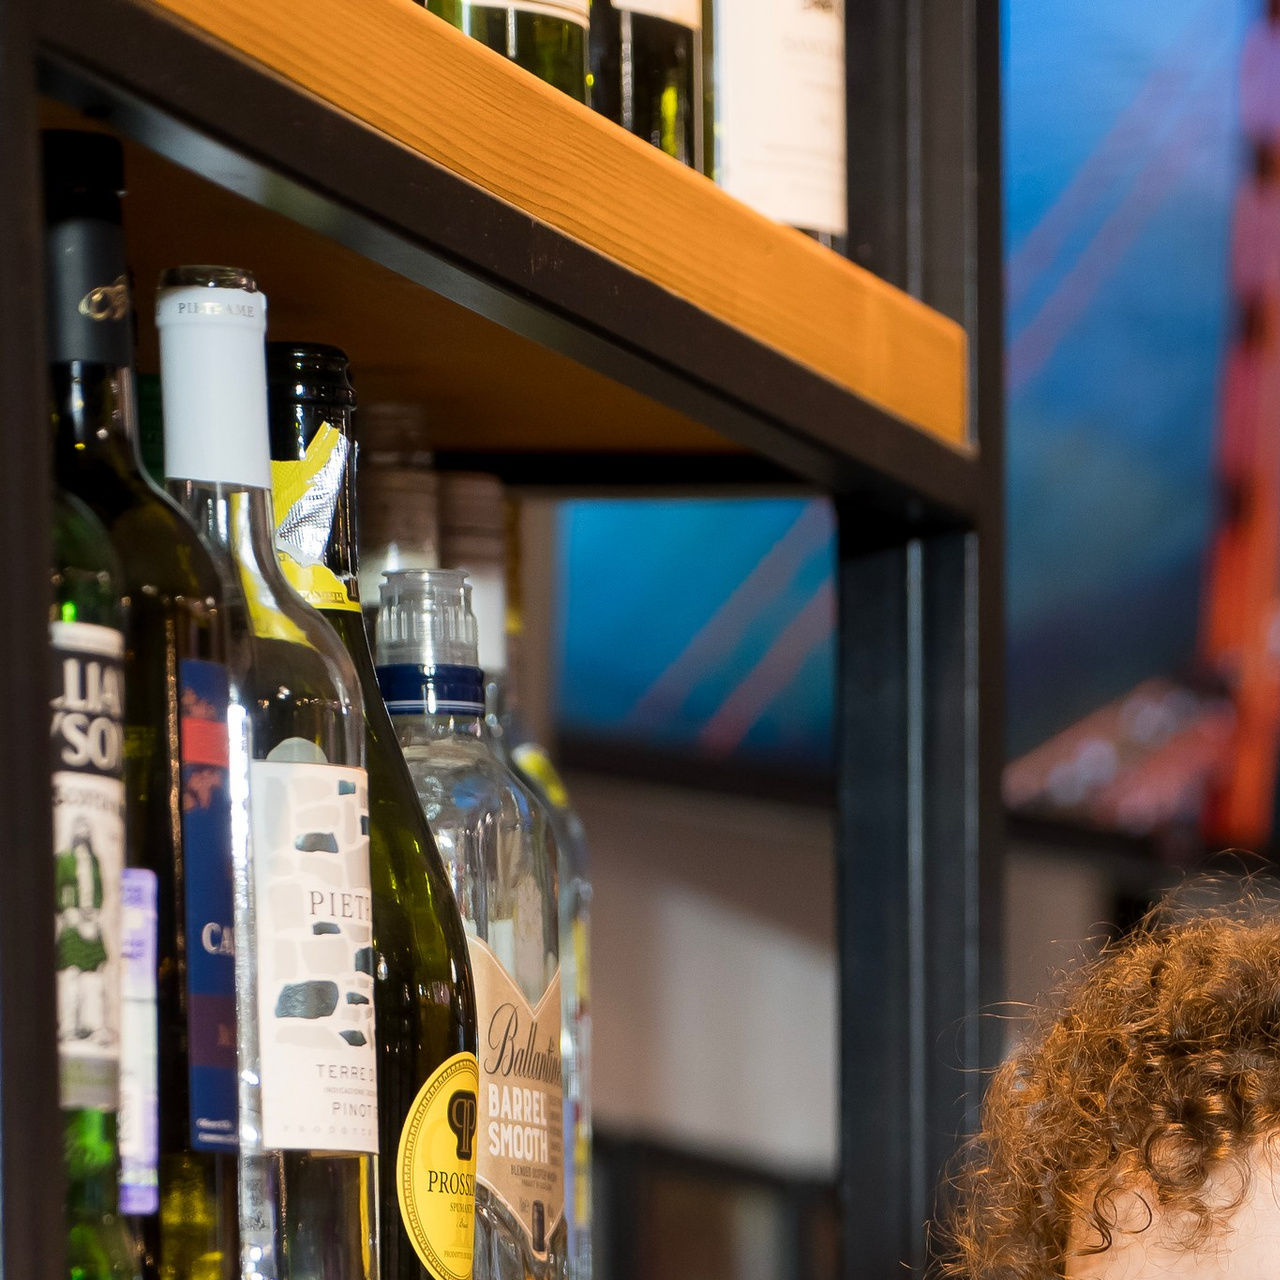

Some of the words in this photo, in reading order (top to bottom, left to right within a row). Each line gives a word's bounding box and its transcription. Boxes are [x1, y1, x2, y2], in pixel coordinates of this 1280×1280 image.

[178, 302, 255, 318] PIEAME
[202, 921, 236, 957] CA
[484, 1003, 562, 1085] Ballantin
[488, 1083, 548, 1126] BARREL
[488, 1121, 549, 1163] SMOOTH
